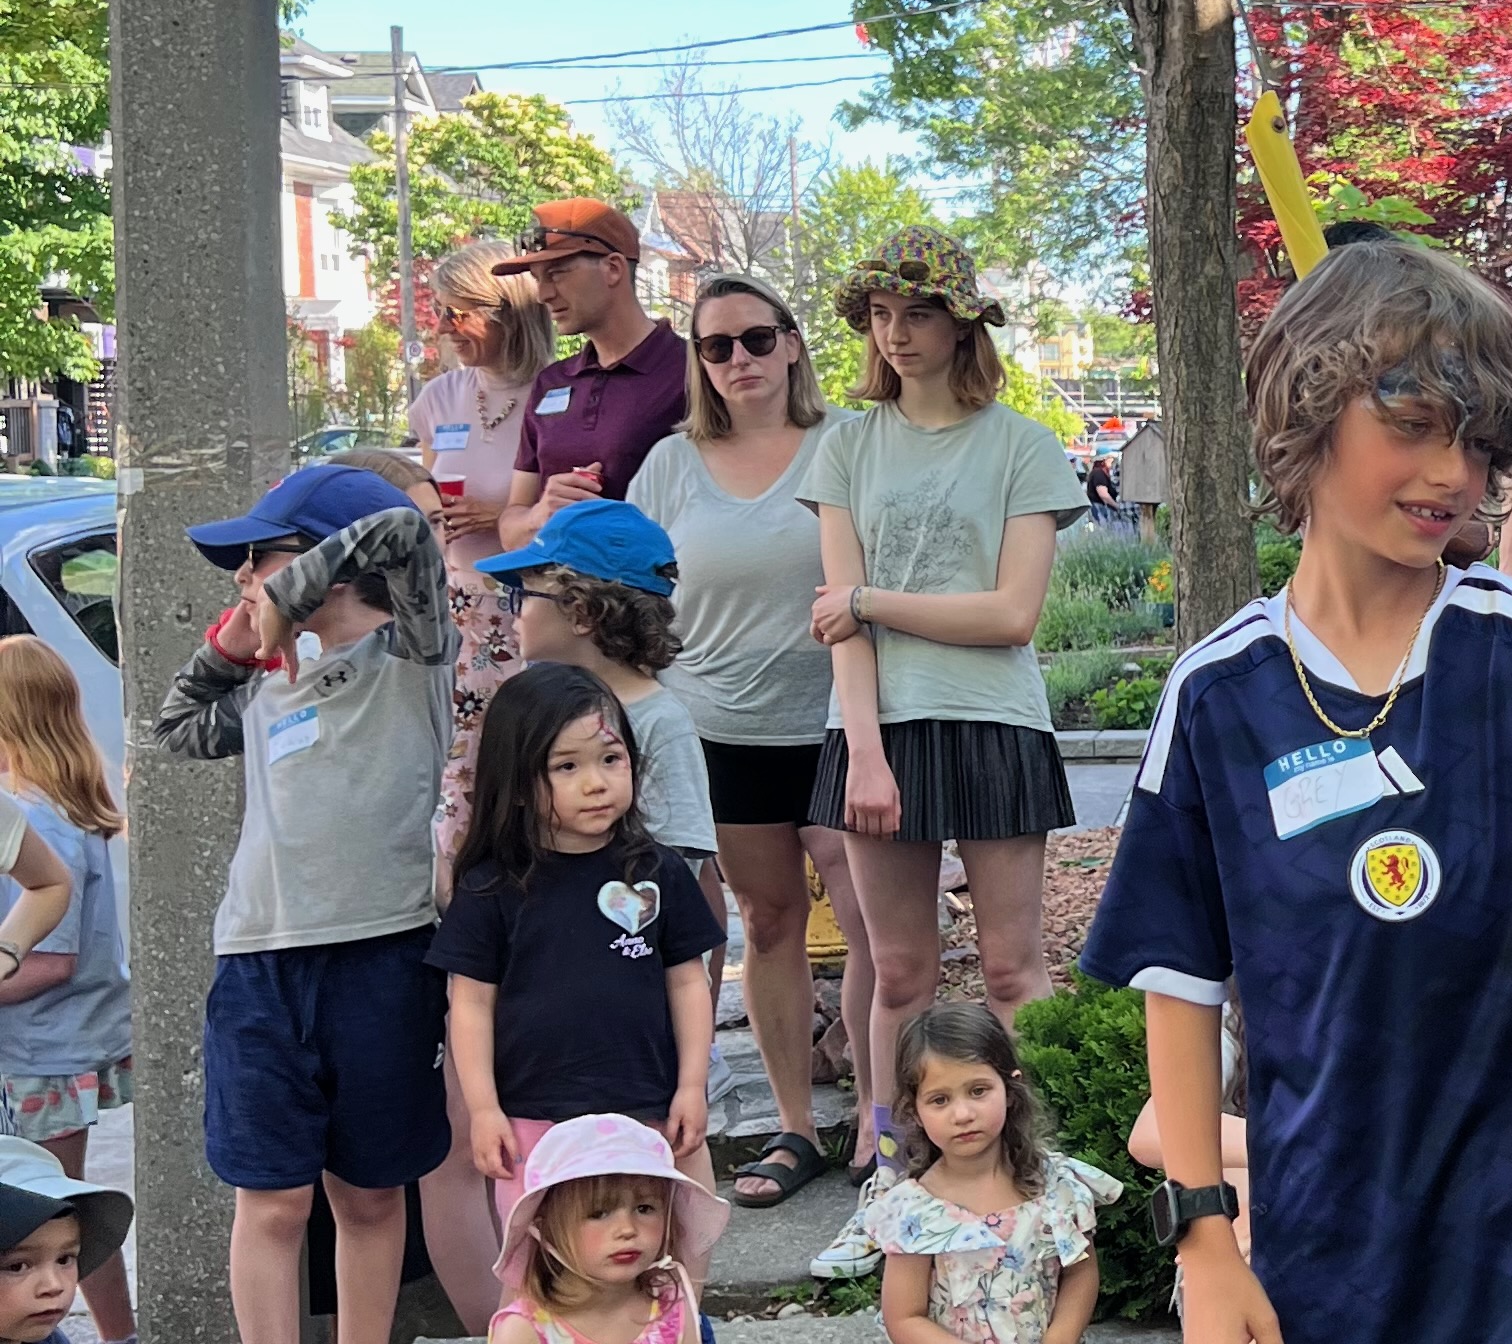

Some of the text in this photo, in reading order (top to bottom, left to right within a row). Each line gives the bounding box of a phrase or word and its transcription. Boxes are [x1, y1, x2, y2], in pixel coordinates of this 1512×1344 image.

[276, 710, 307, 730] HELLO
[1278, 740, 1347, 773] HELLO
[1284, 762, 1348, 819] GREY
[1370, 835, 1412, 848] SCOTLAND
